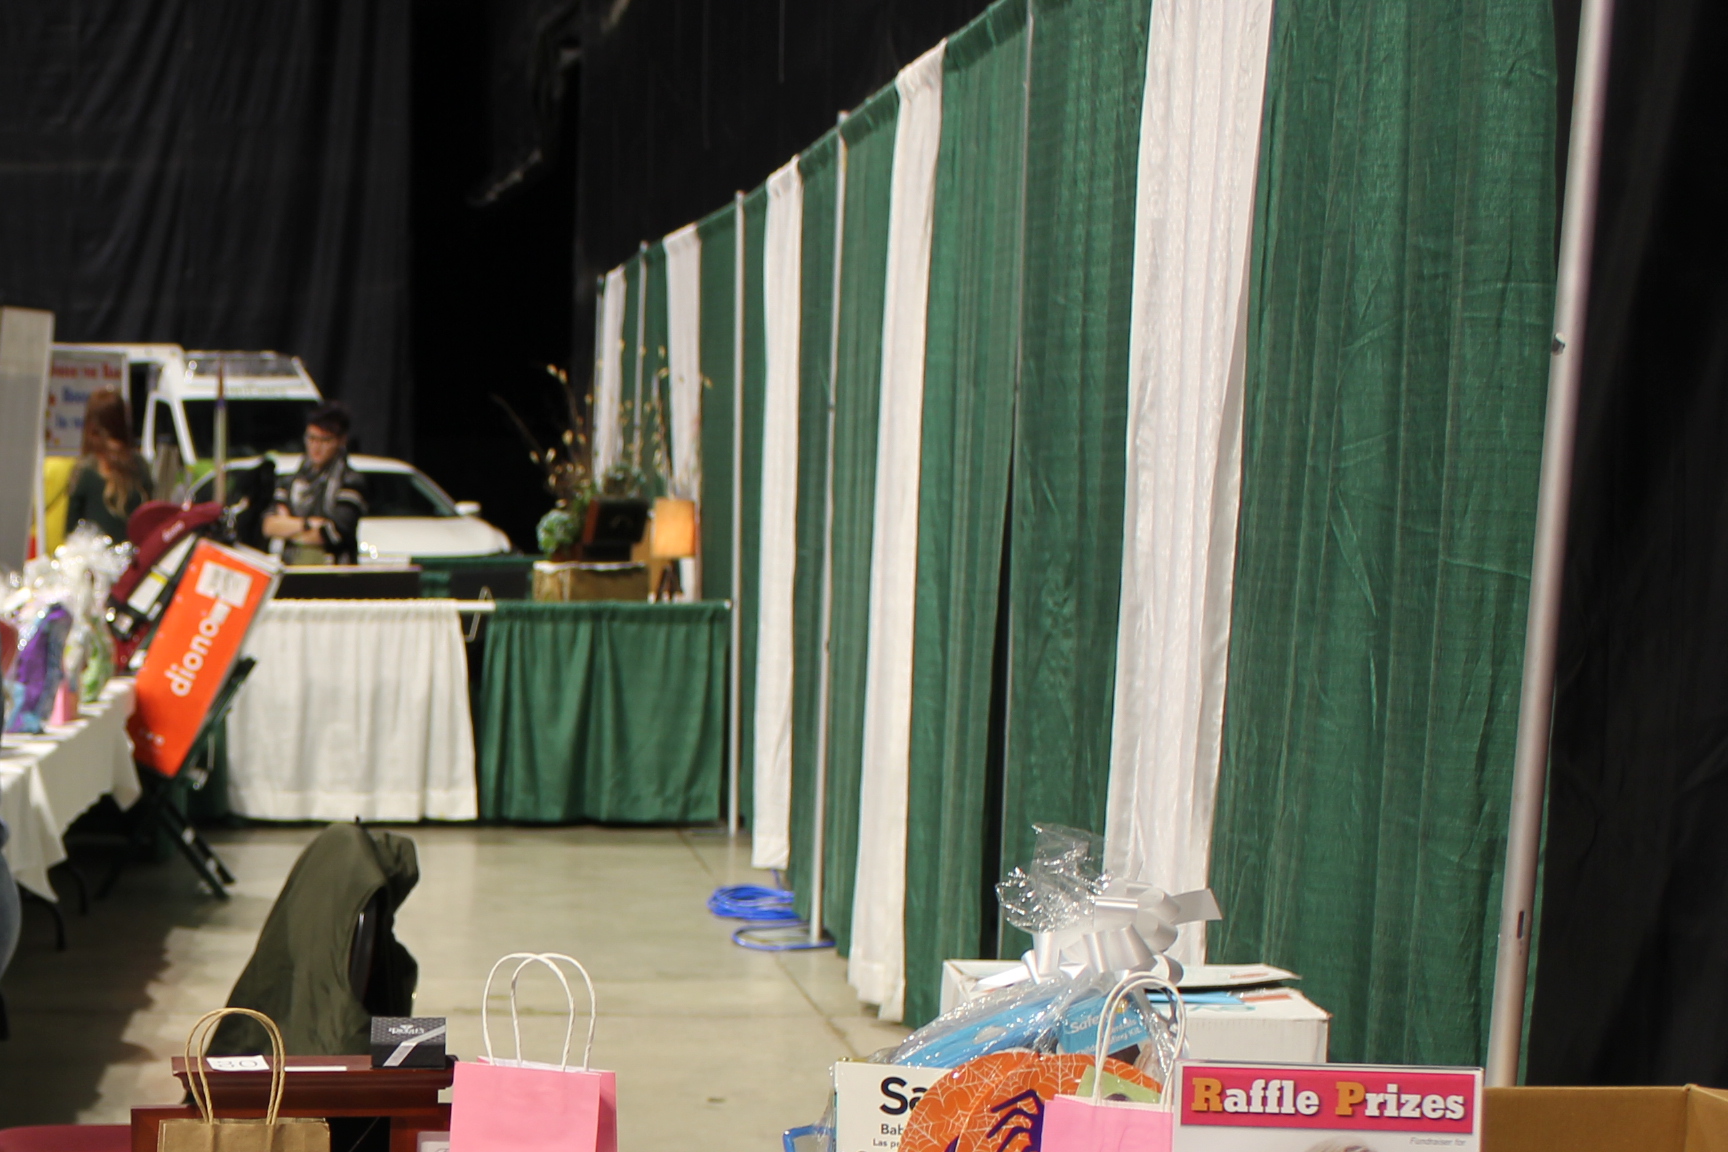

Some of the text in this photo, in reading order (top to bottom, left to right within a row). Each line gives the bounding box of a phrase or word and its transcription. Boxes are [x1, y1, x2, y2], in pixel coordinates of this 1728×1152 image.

[165, 617, 220, 698] diono
[1069, 1010, 1110, 1034] Safe
[1190, 1077, 1466, 1121] Raffle Prizes
[872, 1138, 888, 1148] Las
